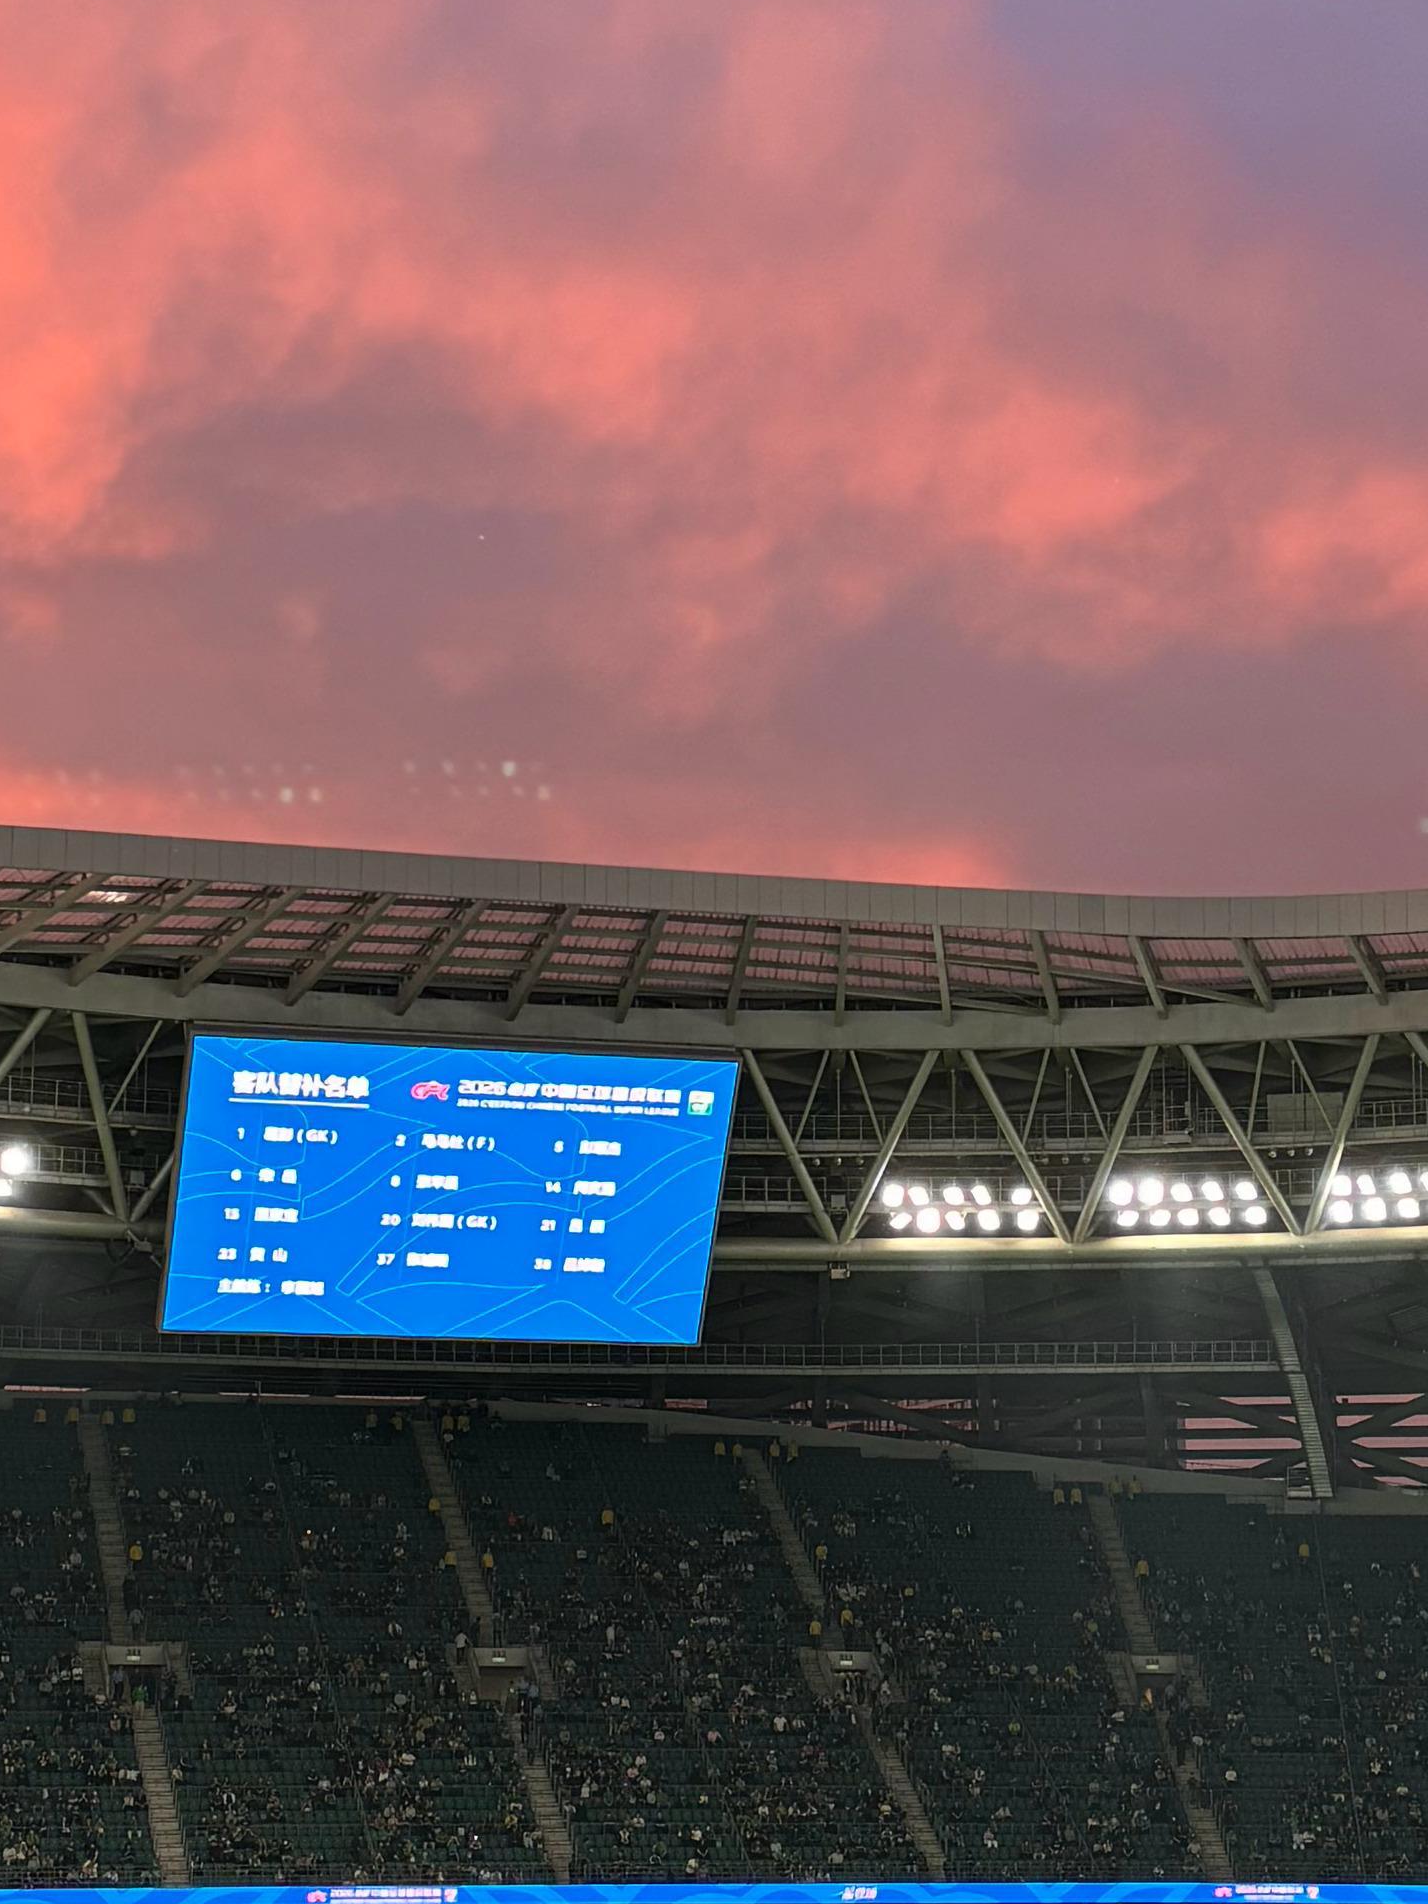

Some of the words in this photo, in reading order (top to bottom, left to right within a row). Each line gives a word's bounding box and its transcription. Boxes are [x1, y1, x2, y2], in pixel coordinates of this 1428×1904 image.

[232, 1070, 369, 1098] 客队替补名单
